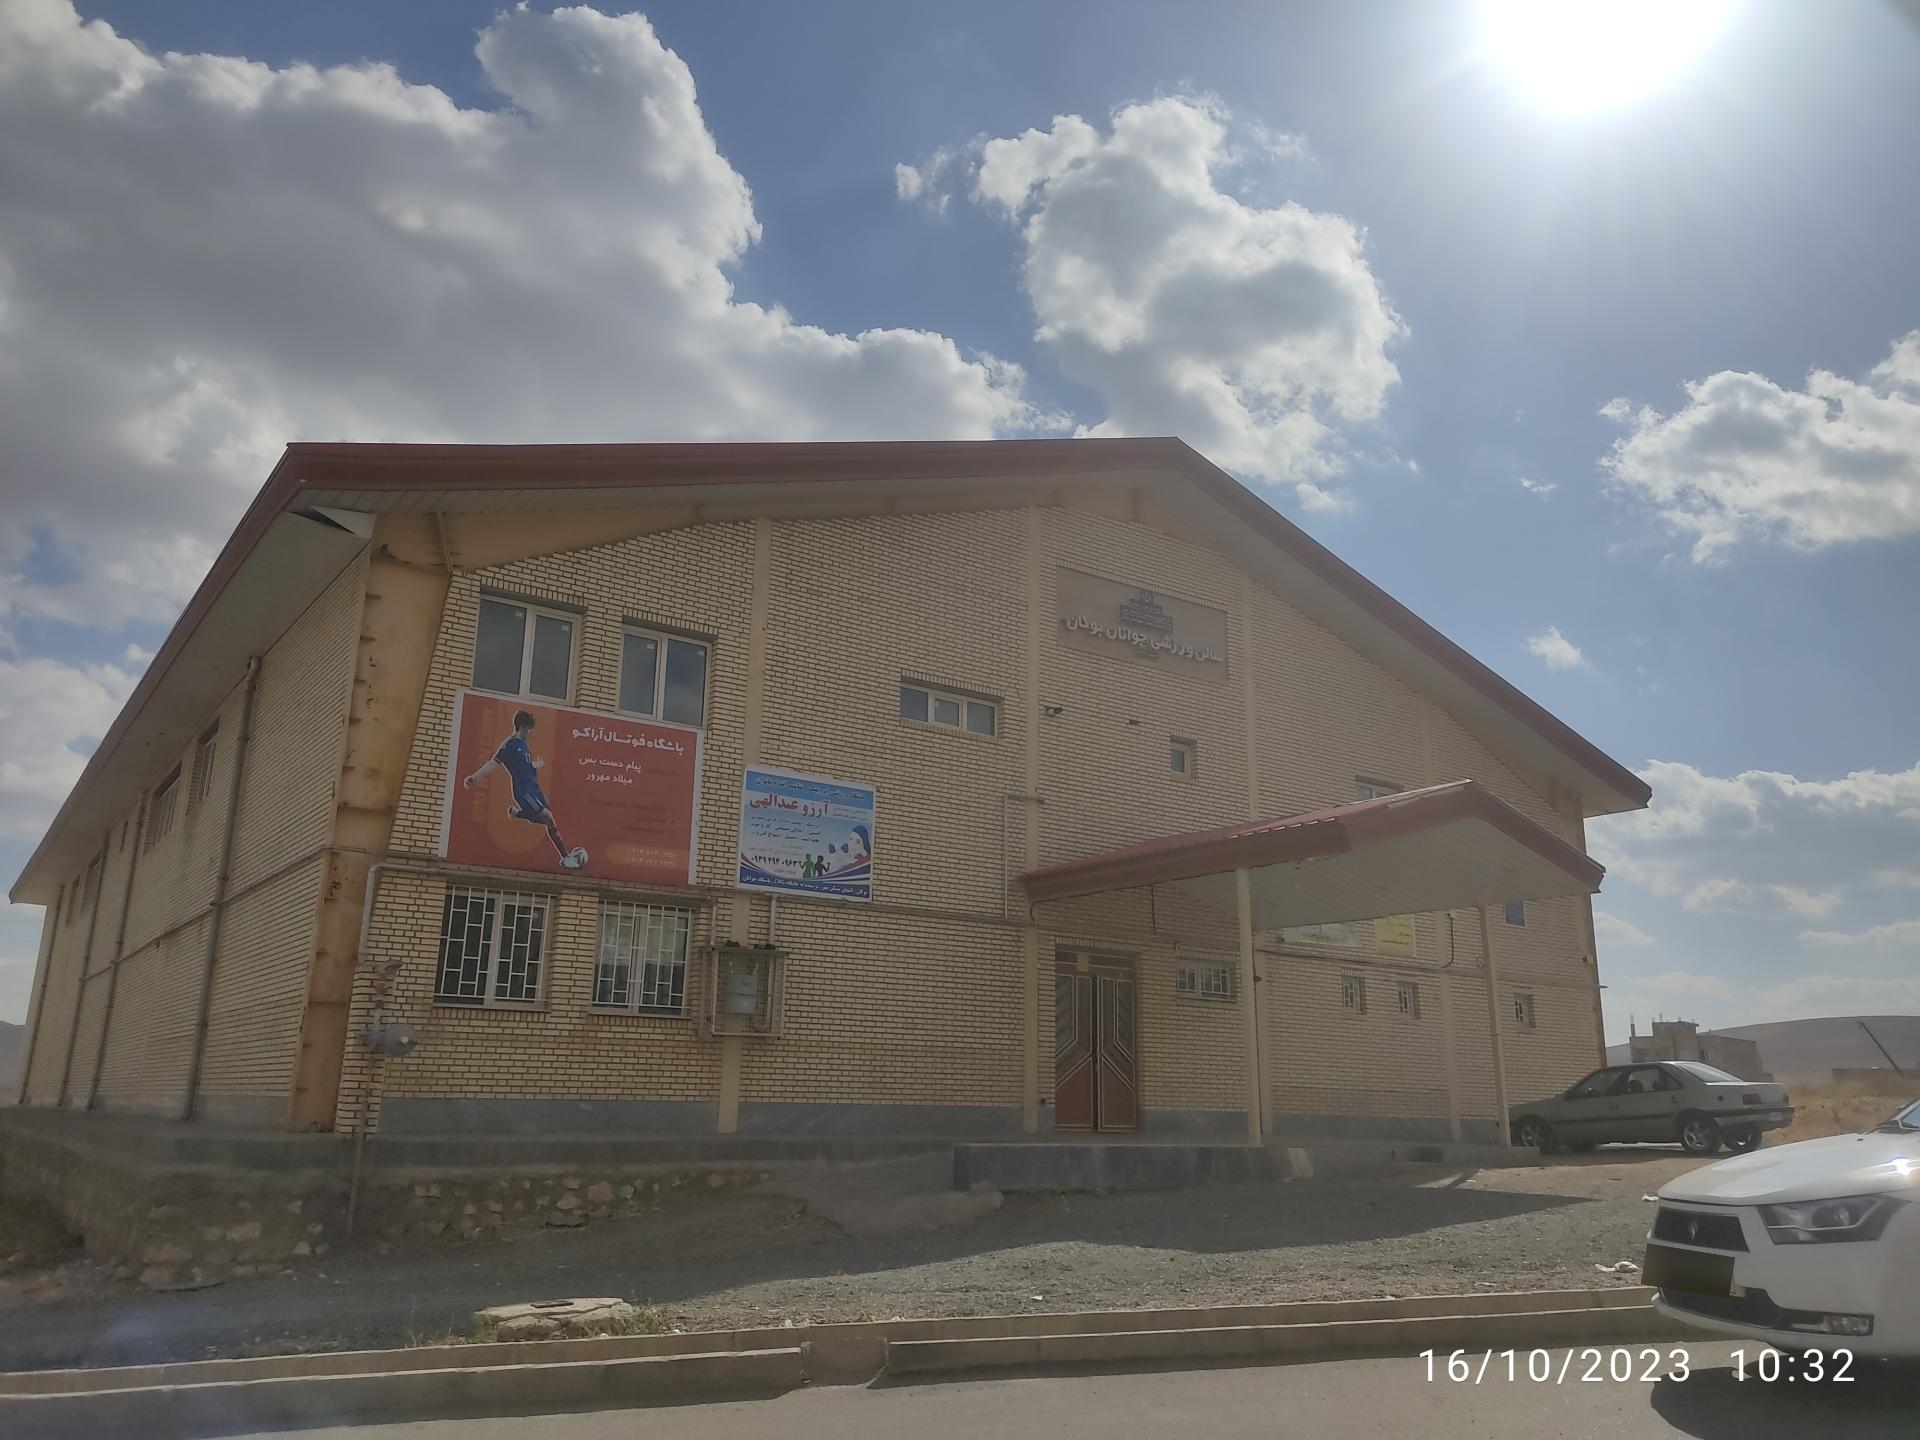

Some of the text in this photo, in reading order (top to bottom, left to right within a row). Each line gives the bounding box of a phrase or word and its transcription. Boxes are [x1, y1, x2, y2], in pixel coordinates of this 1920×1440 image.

[1067, 613, 1104, 637] بوکان
[1106, 624, 1147, 645] جوانان
[1150, 634, 1194, 657] ورزشی
[1195, 645, 1225, 664] سالن
[646, 738, 684, 756] باشگاه
[599, 758, 624, 768] دست
[612, 773, 633, 786] میلاد
[801, 800, 831, 818] آرزو
